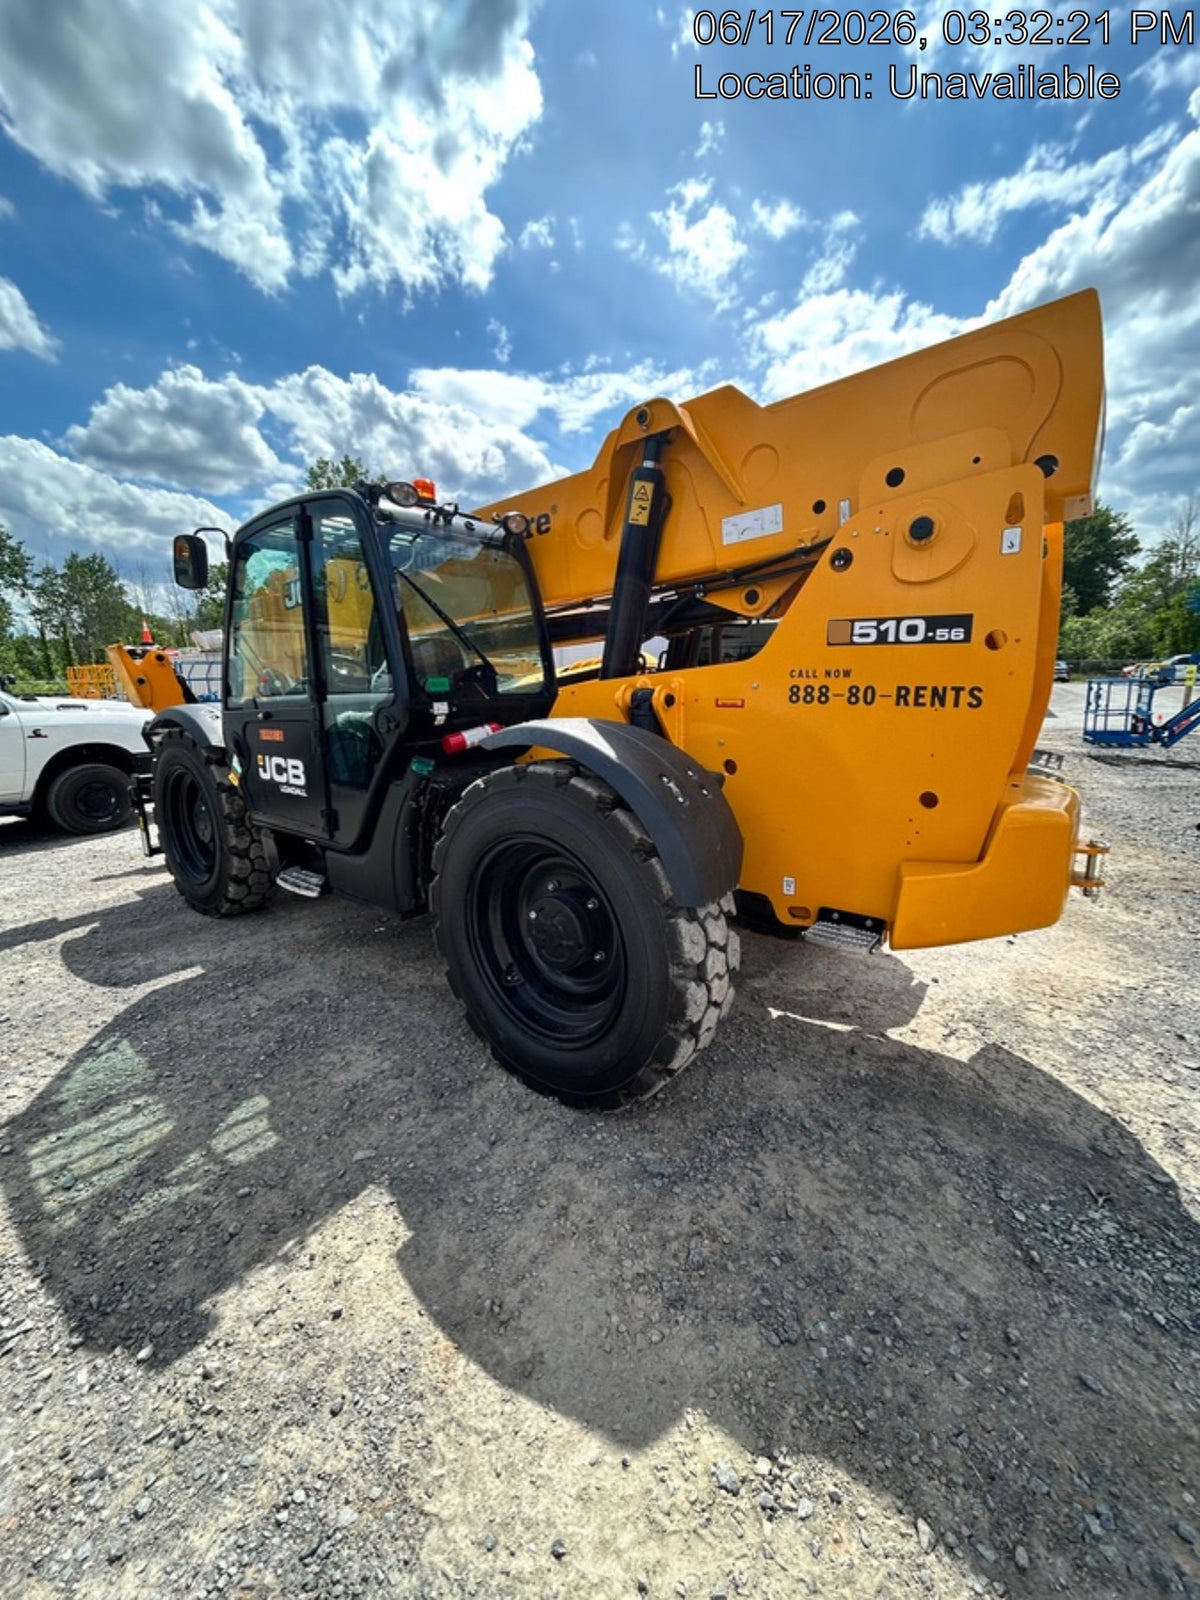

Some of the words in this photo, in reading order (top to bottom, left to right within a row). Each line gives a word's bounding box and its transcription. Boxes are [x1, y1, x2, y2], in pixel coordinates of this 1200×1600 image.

[789, 669, 818, 679] CALL
[824, 669, 852, 679] NOW
[788, 684, 984, 709] 888-80-RENTS
[257, 754, 306, 786] JCB
